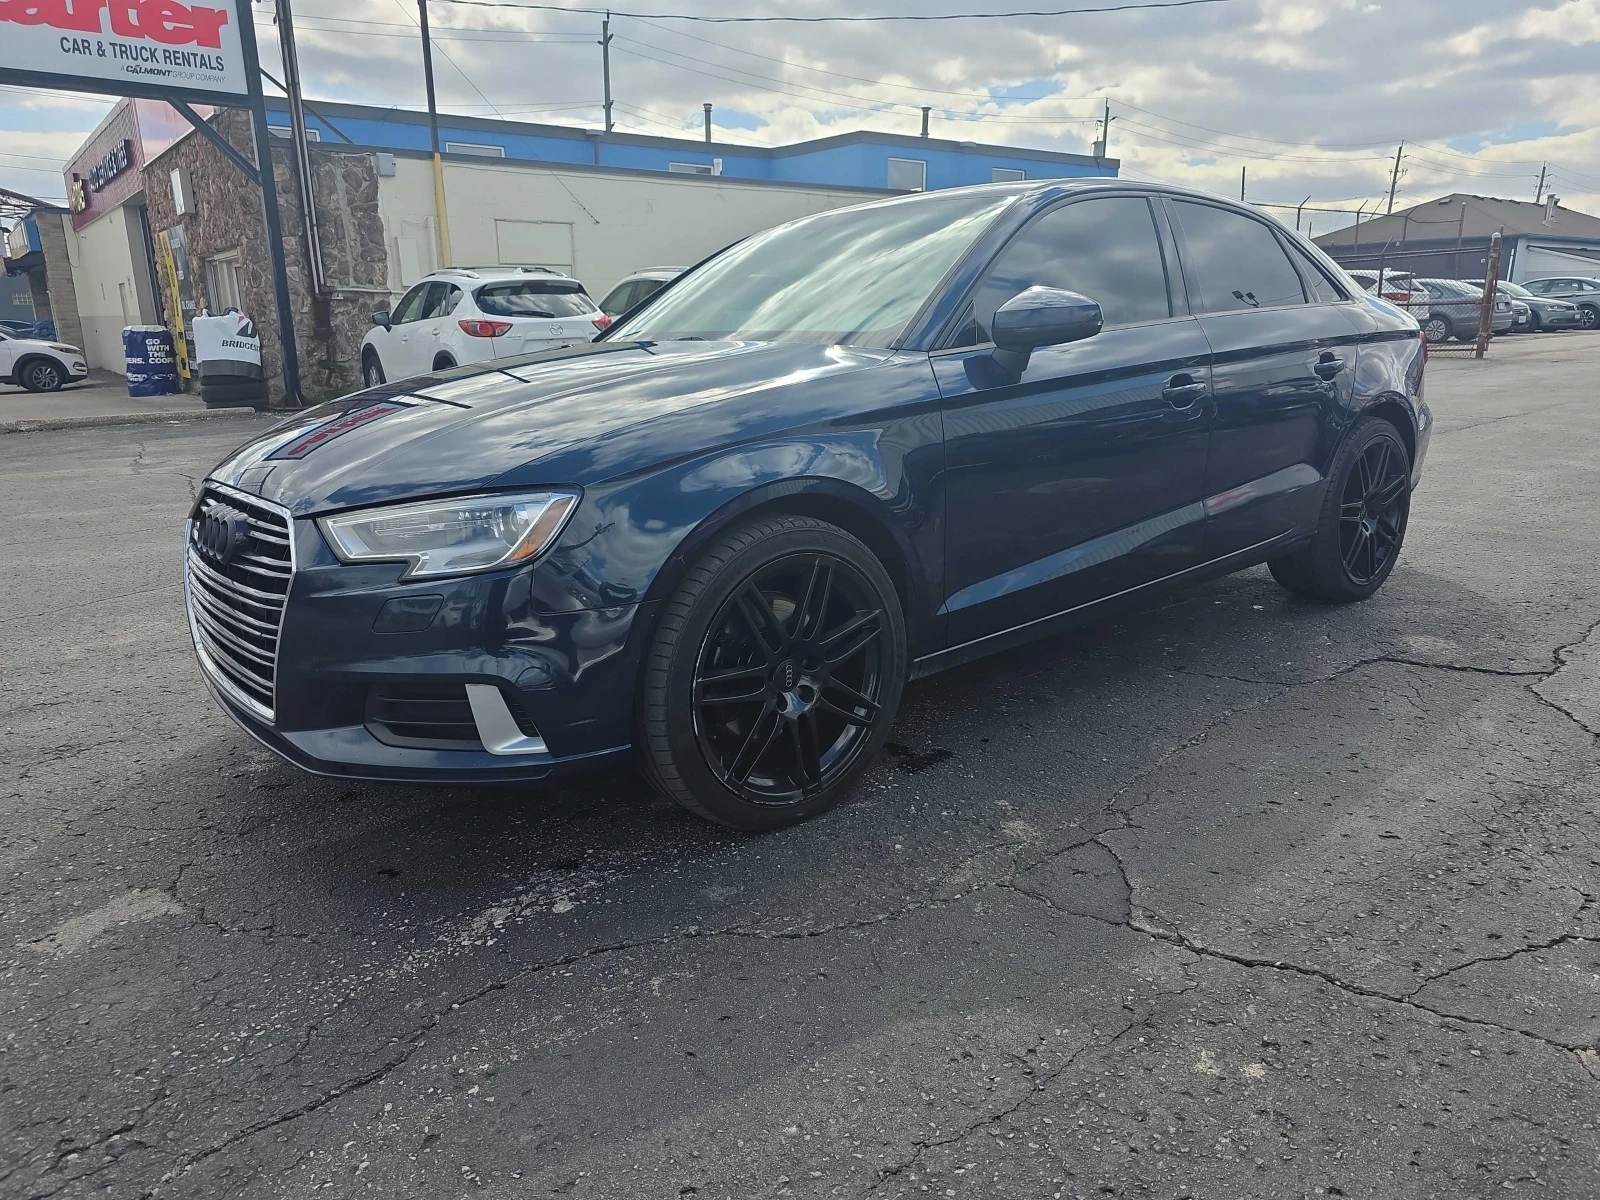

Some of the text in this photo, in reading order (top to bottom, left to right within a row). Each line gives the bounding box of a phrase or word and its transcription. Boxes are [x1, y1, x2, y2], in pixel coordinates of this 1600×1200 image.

[0, 0, 228, 49] arter
[60, 37, 225, 72] CAR & TRUCK RENTALS
[126, 65, 172, 77] CALMONT
[172, 71, 195, 80] GROUP
[195, 72, 226, 83] COMPANY
